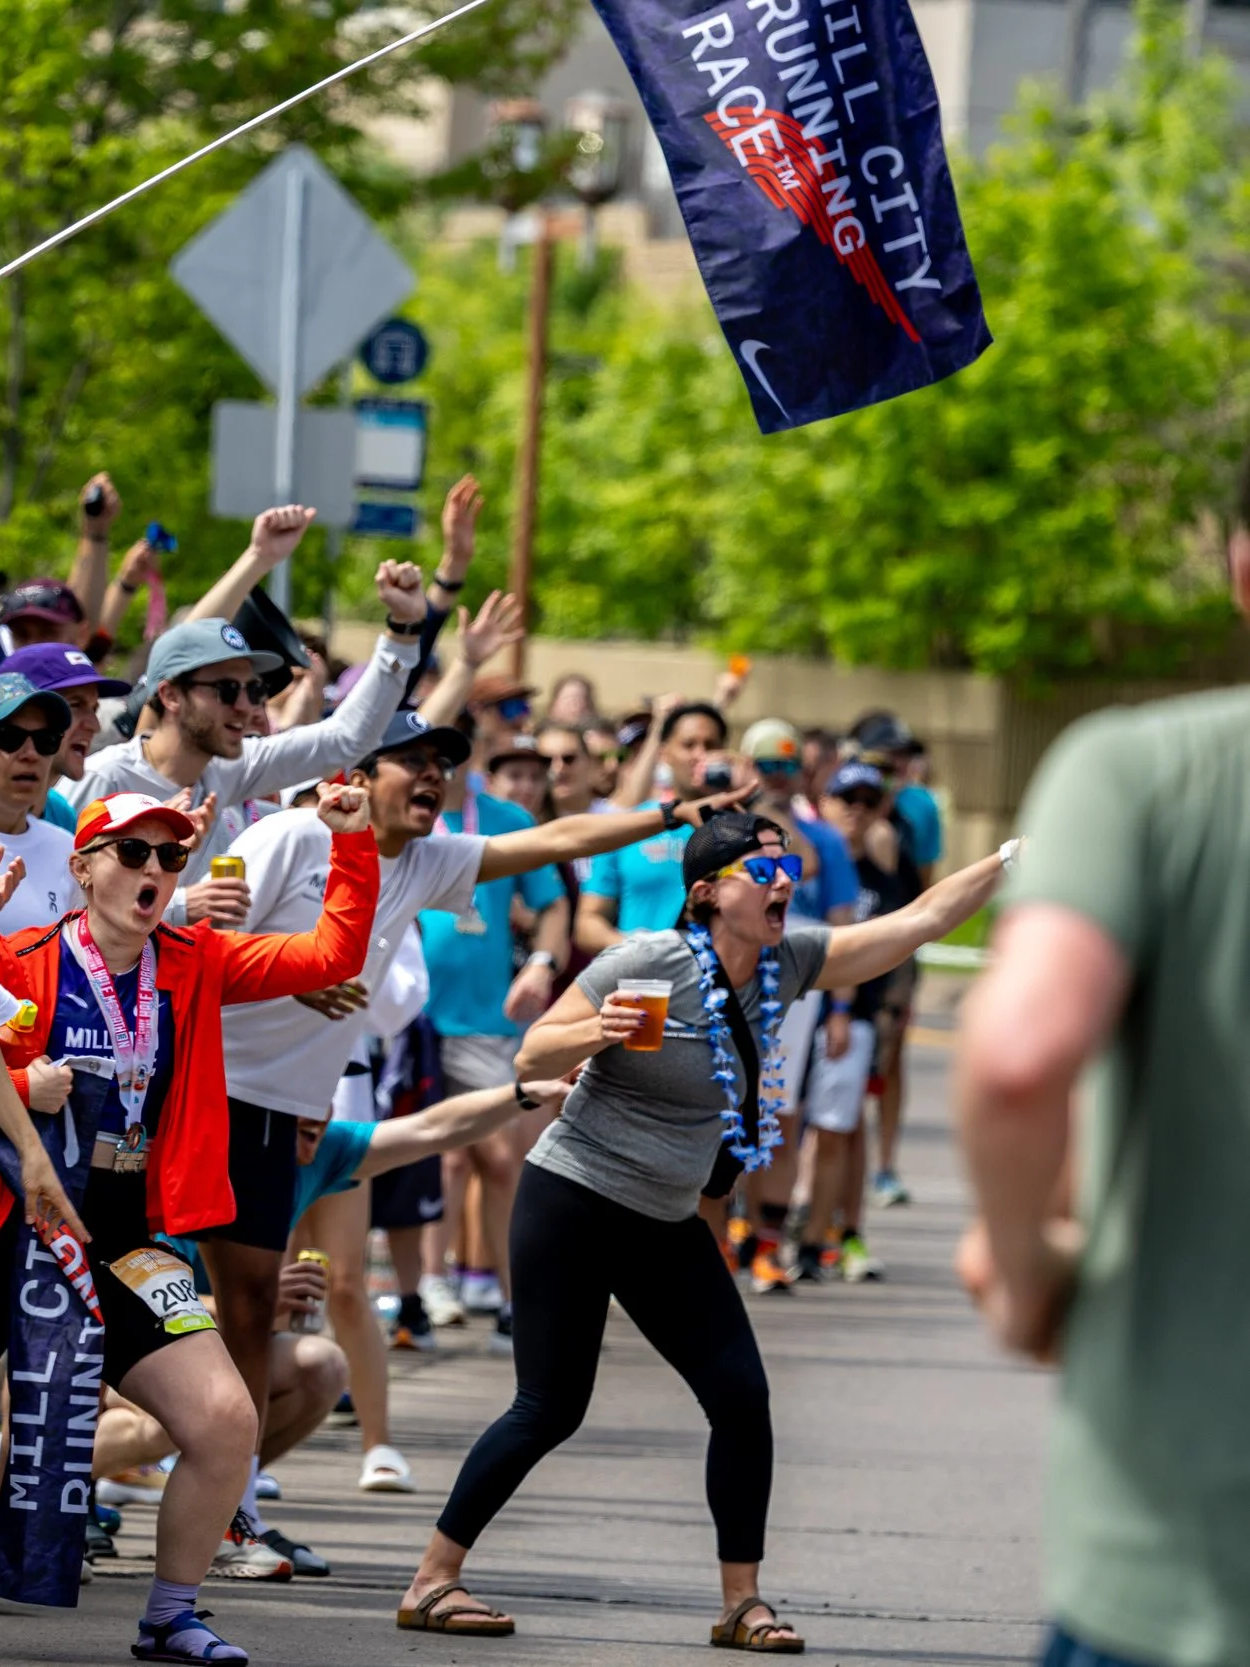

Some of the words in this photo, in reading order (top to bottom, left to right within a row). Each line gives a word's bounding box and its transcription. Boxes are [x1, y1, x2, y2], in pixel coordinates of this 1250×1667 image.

[819, 0, 879, 124] ILL
[860, 144, 942, 292] CITY
[65, 1026, 113, 1050] MILL
[9, 1351, 58, 1511] MILL
